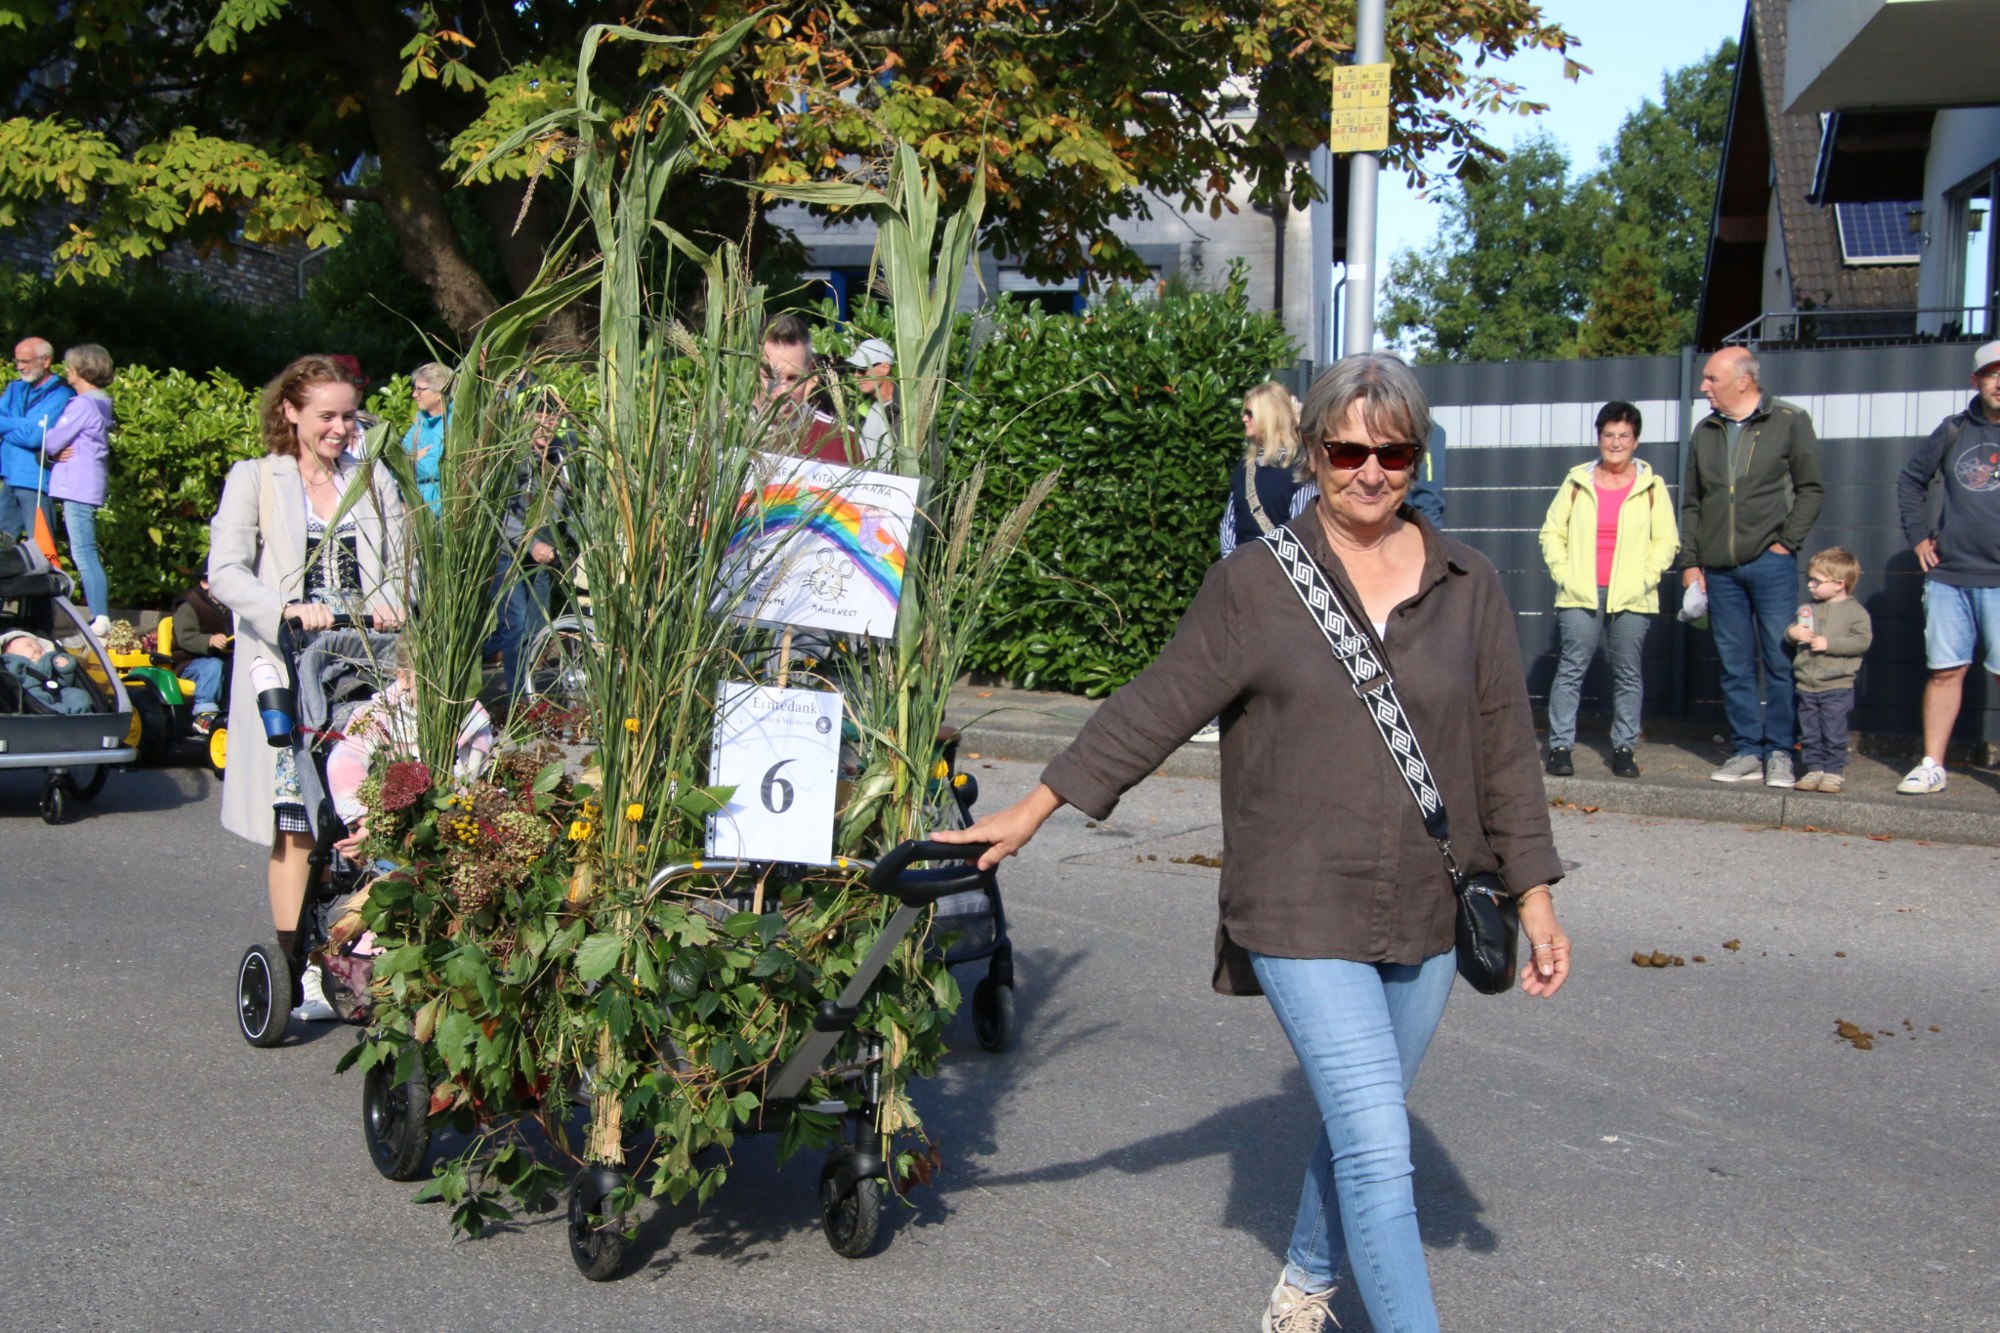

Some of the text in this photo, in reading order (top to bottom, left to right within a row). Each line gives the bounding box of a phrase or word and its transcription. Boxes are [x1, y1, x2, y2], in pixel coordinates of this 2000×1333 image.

[862, 483, 892, 498] ANNA
[753, 697, 818, 714] Erntedank
[760, 758, 798, 813] 6
